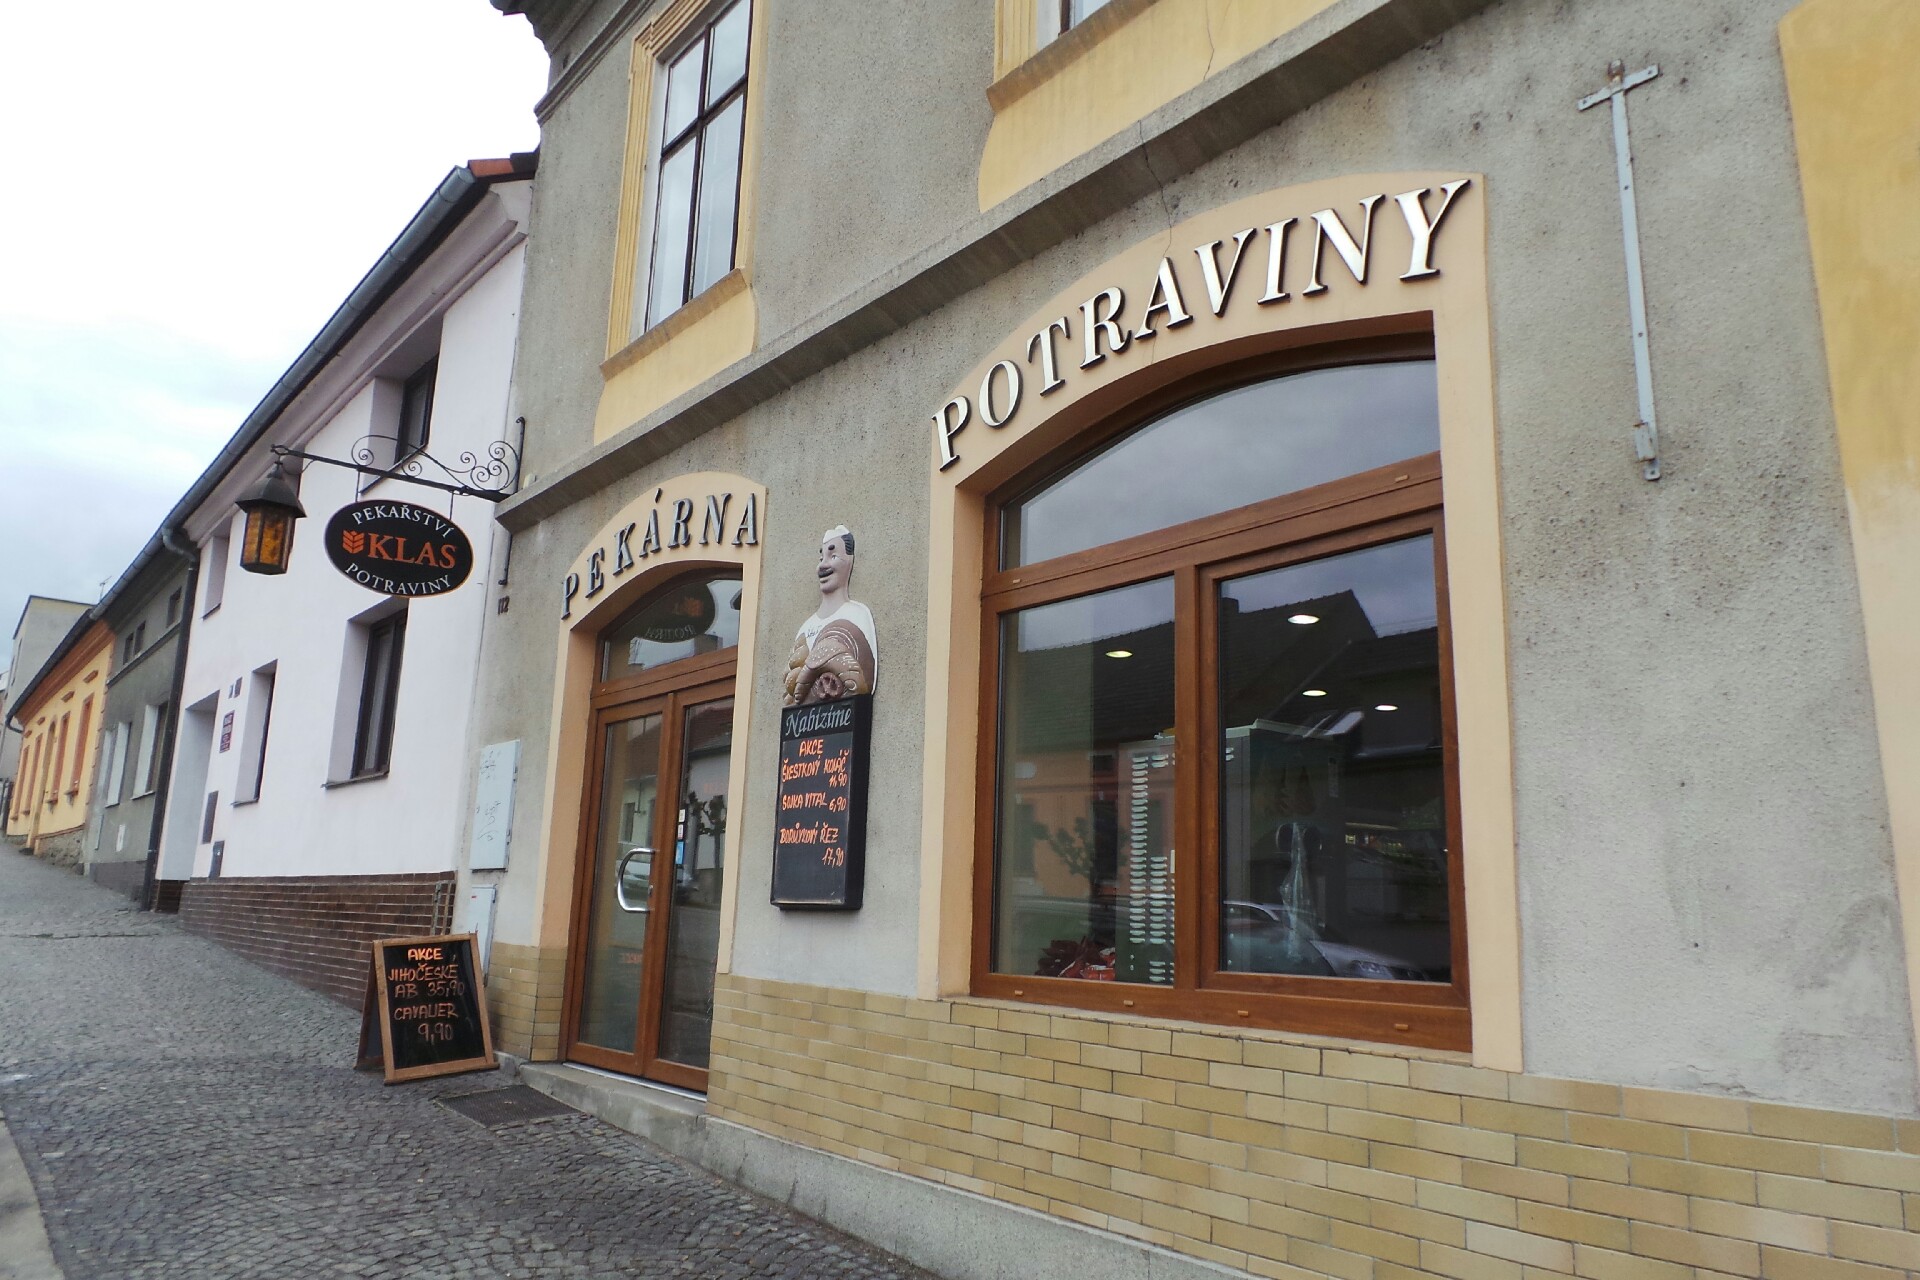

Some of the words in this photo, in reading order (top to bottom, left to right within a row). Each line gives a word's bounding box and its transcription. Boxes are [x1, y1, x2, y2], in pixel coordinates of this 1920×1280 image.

[931, 179, 1471, 472] POTRAVINY
[352, 505, 454, 538] PEKAŘSTVÍ
[367, 532, 457, 569] KLAS
[561, 488, 759, 620] PEKÁRNA
[345, 563, 451, 594] POTRAVINY
[799, 739, 823, 757] AKCE
[828, 796, 847, 812] 6,90
[820, 822, 839, 843] ŘEZ
[407, 947, 443, 961] AKCE
[394, 983, 418, 998] AB
[427, 980, 465, 998] 35,90
[417, 1022, 454, 1045] 9,90
